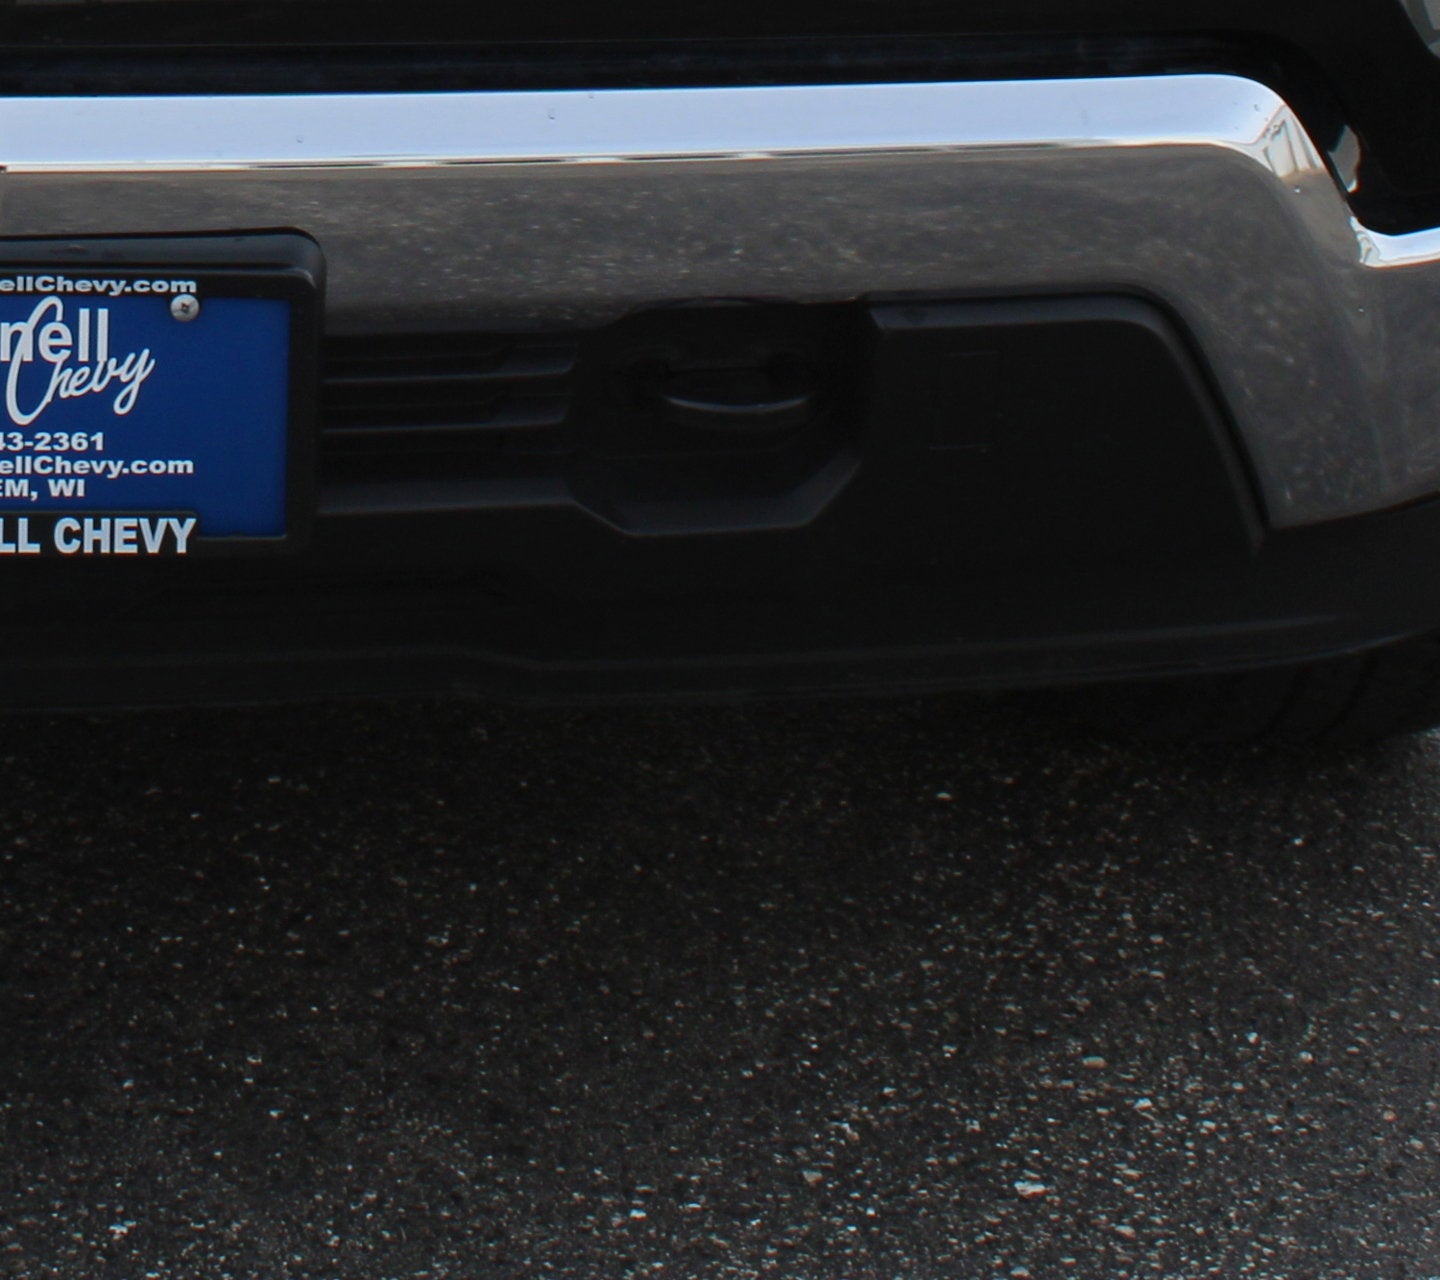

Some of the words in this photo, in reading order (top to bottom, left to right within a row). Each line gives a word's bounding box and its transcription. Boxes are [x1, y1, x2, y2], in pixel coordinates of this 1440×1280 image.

[5, 296, 155, 425] Chevy
[48, 479, 85, 497] WI
[54, 517, 196, 553] CHEVY
